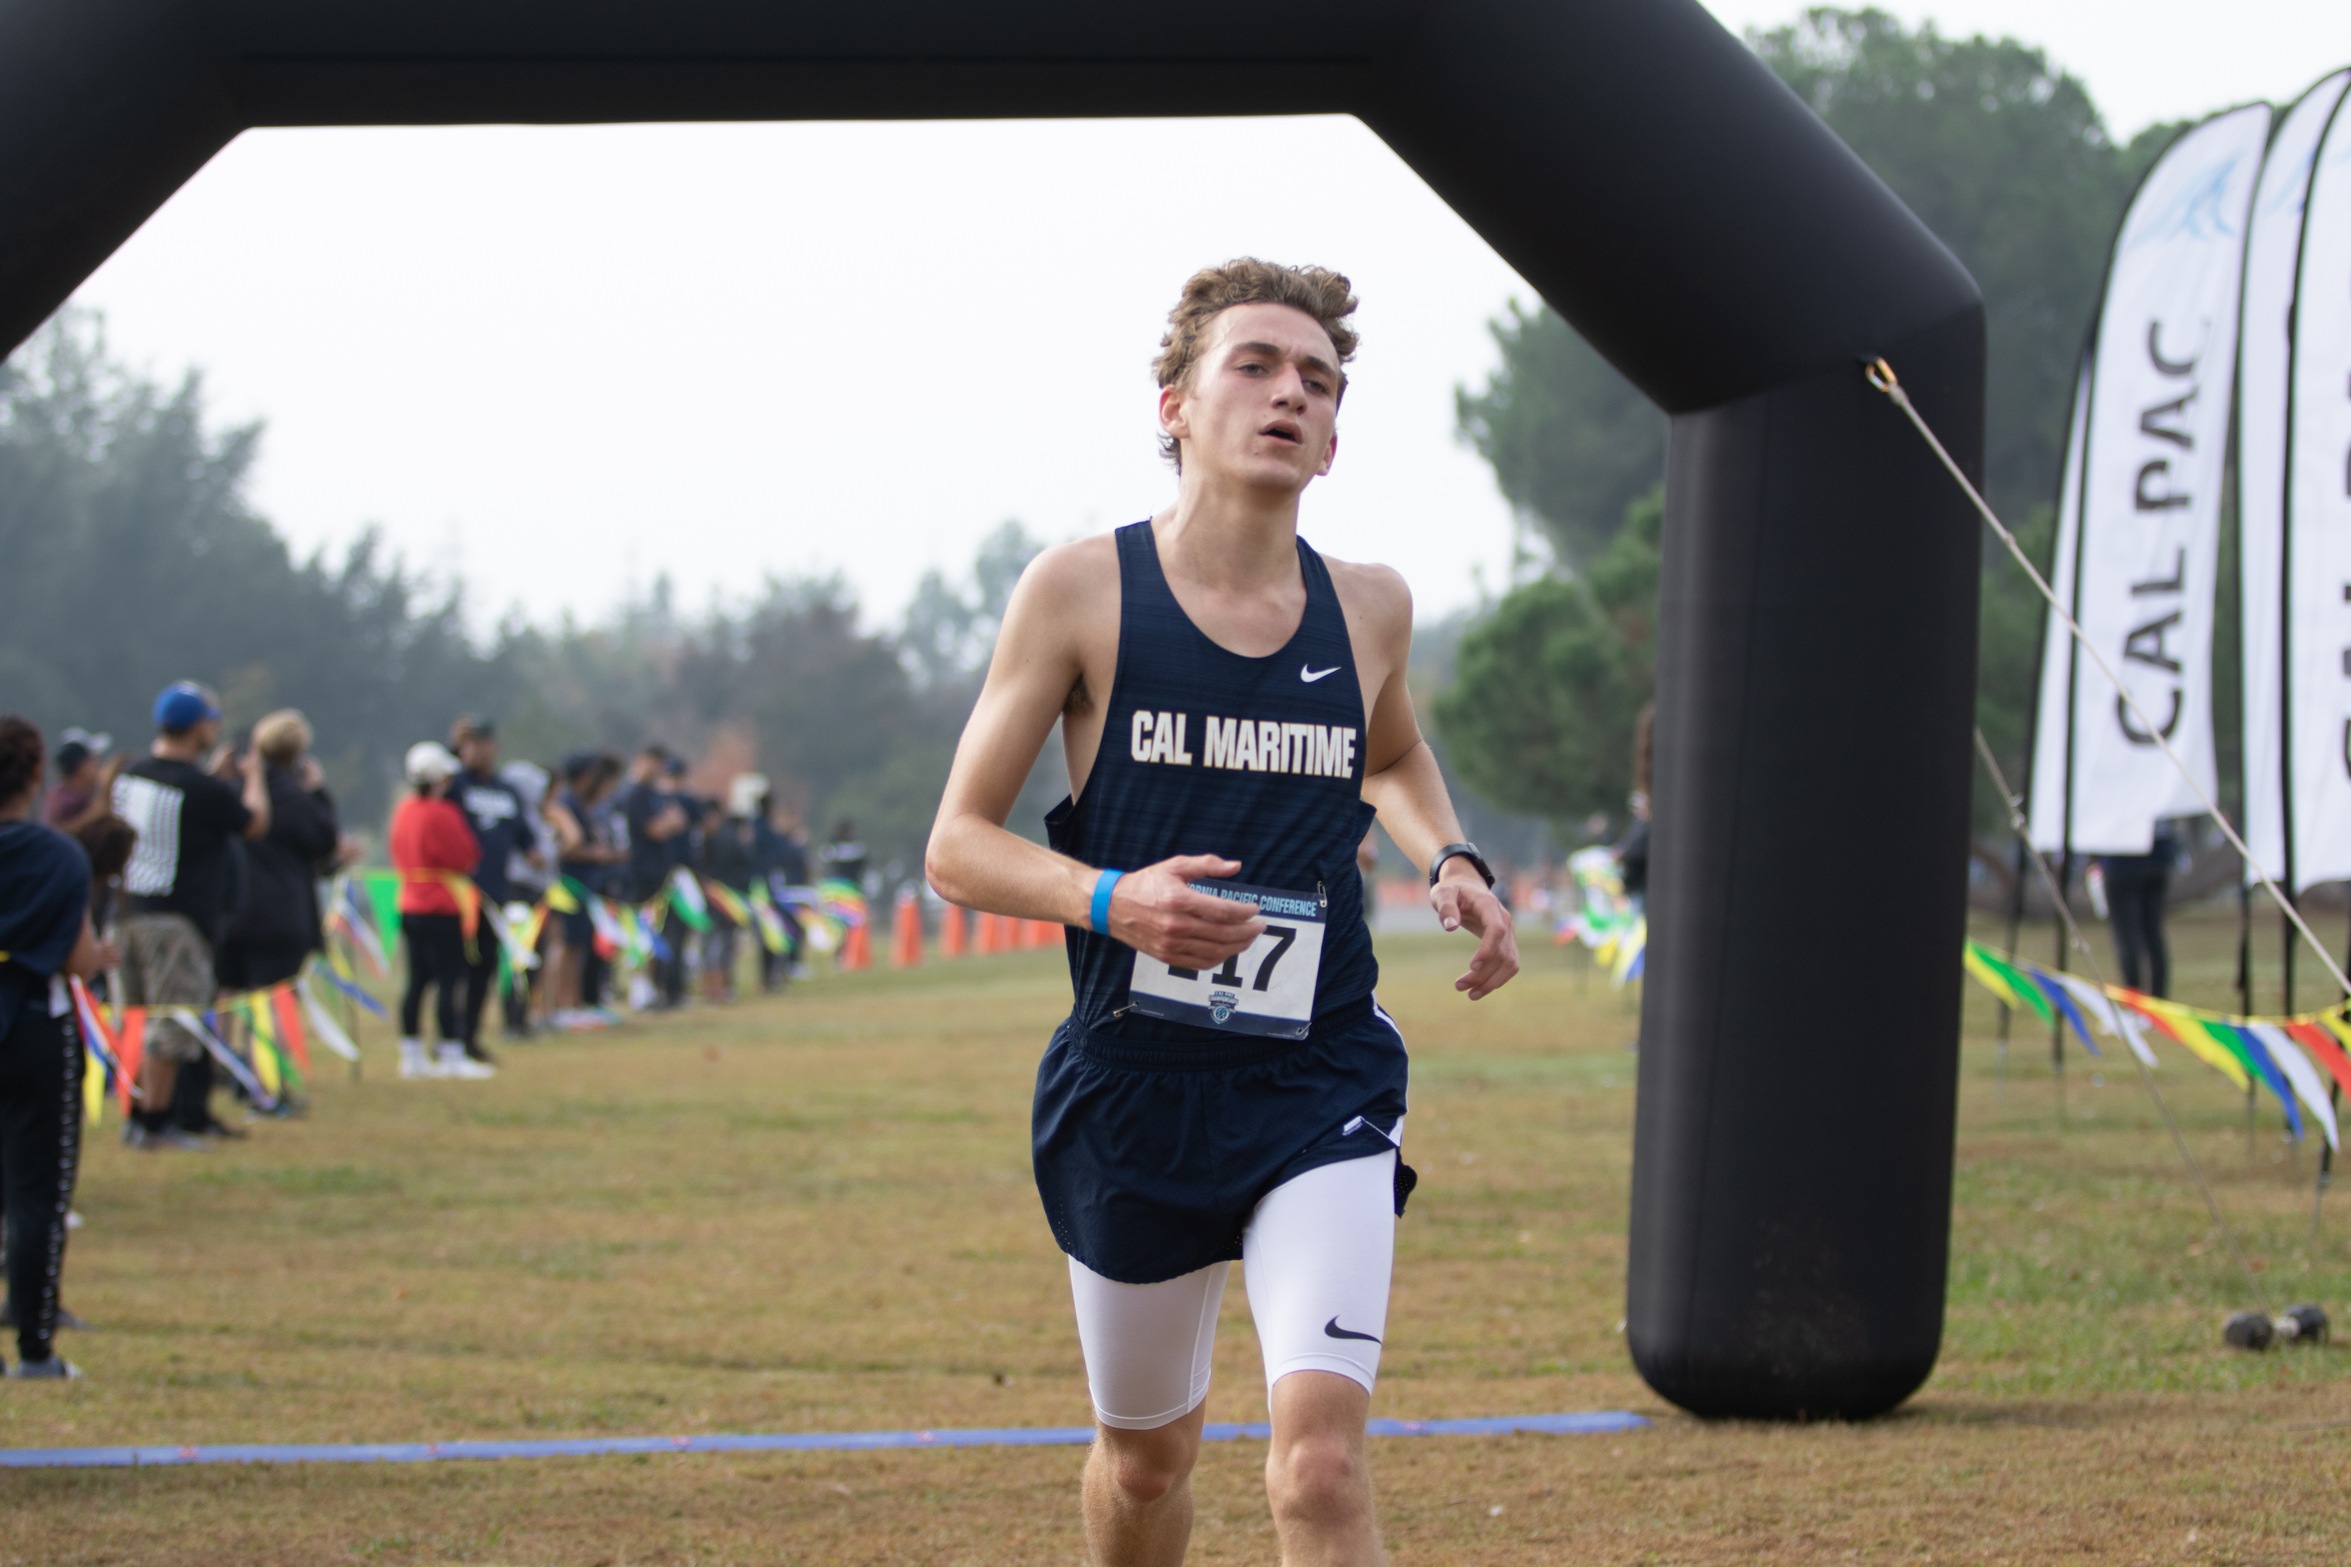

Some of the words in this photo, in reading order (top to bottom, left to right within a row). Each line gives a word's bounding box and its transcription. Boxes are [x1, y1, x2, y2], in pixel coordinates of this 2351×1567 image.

[2133, 316, 2212, 516] PAC
[2115, 546, 2185, 749] CAL
[1131, 709, 1193, 766] CAL
[1202, 715, 1357, 779] MARITIME
[1220, 888, 1259, 905] PACIFIC
[1260, 895, 1318, 917] CONFERENCE
[1167, 924, 1297, 992] 17
